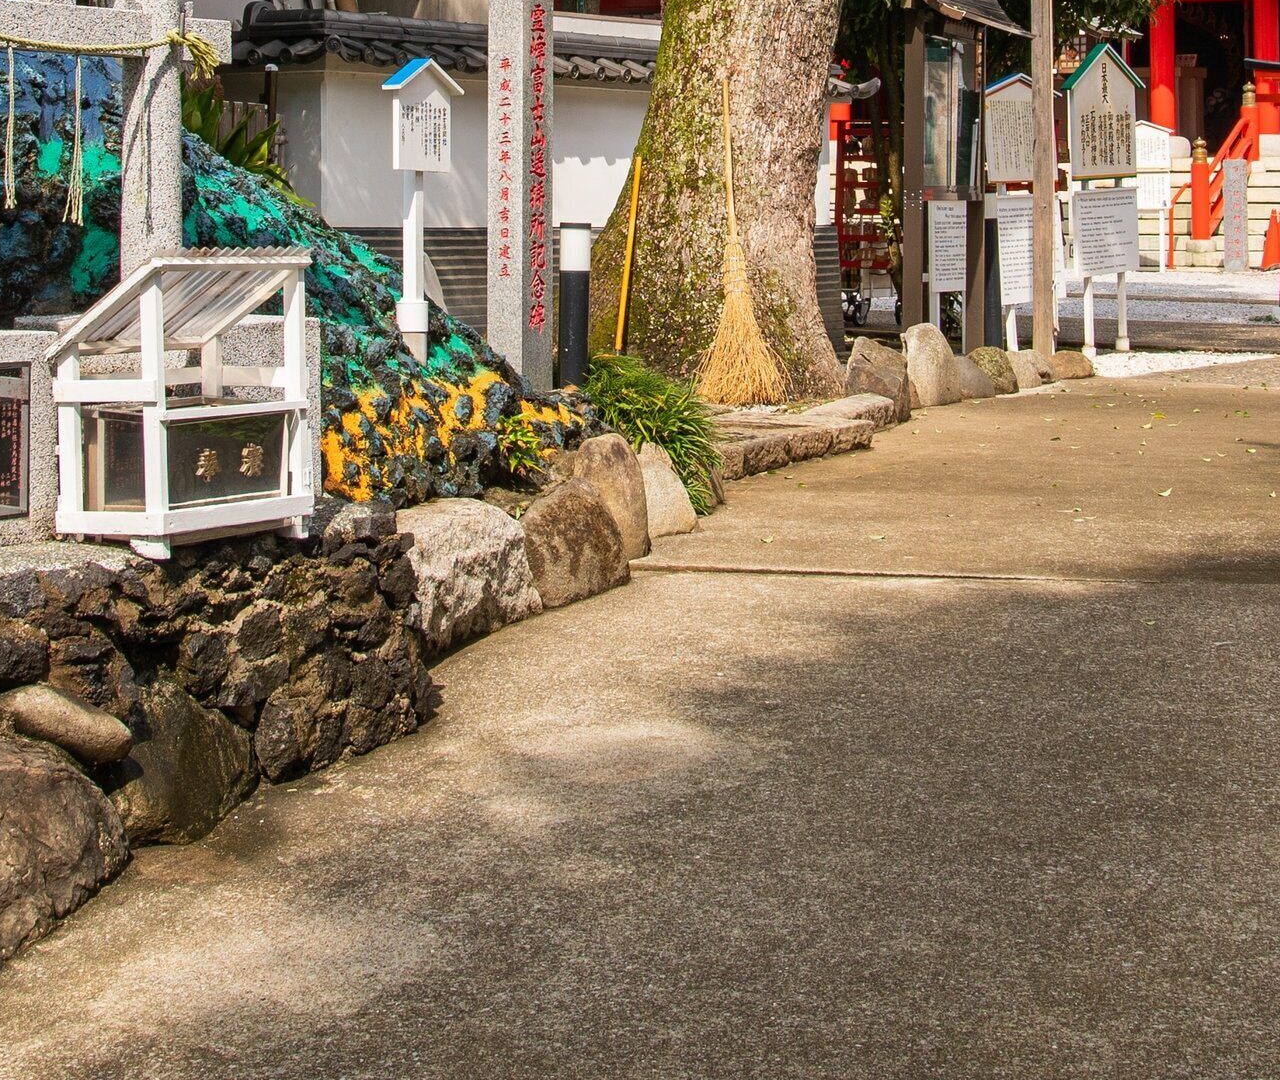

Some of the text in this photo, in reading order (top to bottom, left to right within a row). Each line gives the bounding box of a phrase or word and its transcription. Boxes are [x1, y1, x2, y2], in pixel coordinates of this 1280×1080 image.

[1101, 62, 1109, 104] 日本最大
[498, 57, 513, 278] 平成二十三年八月吉日建立
